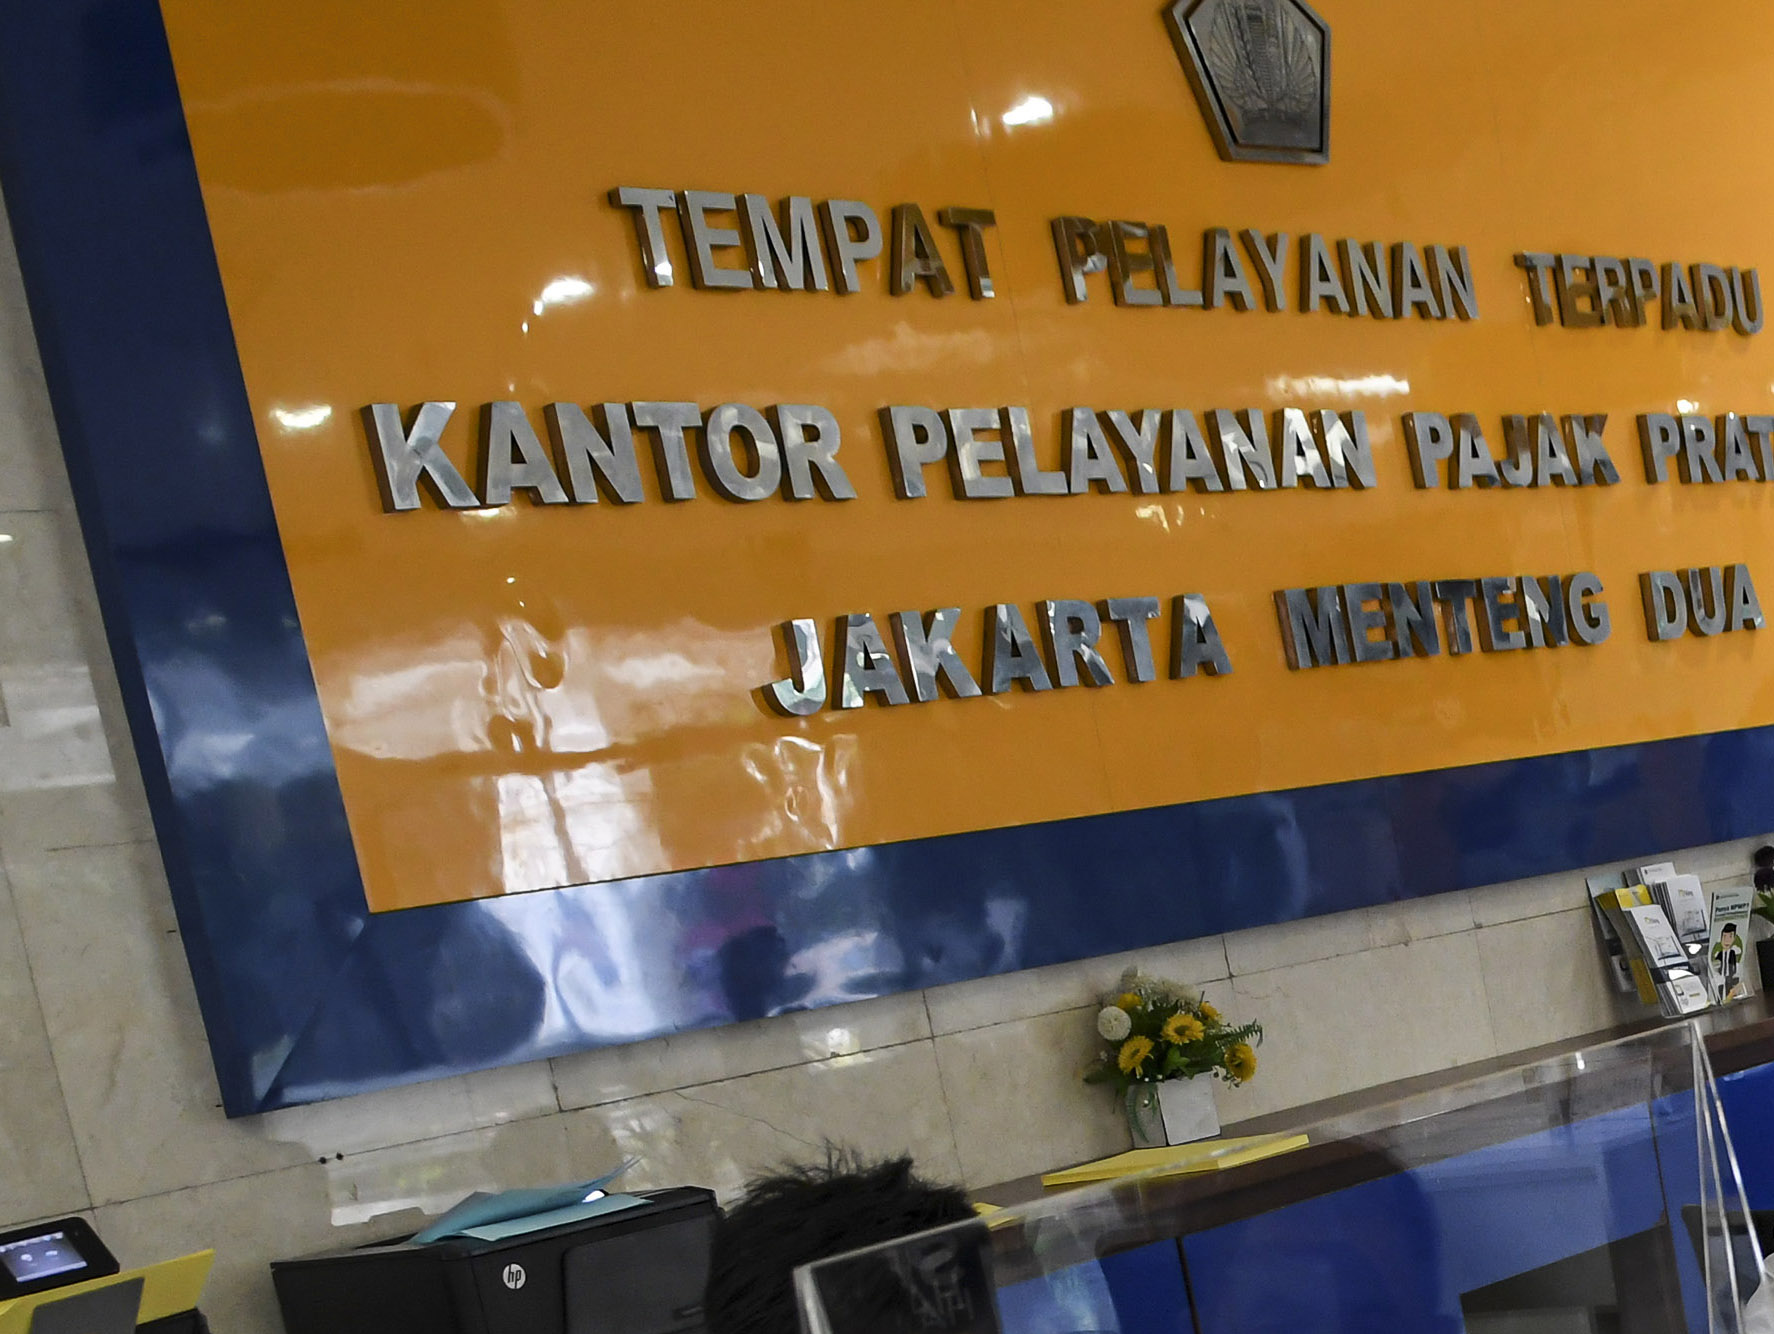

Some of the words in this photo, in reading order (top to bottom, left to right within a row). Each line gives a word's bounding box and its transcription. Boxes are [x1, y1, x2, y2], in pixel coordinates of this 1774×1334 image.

[610, 186, 996, 300] TEMPAT
[1052, 216, 1479, 322] PELAYANAN
[1512, 250, 1766, 336] TERPADU
[361, 401, 858, 513] KANTOR
[877, 405, 1377, 502] PELAYANAN
[1402, 411, 1621, 490] PAJAK
[750, 594, 1233, 718] JAKARTA
[1272, 571, 1611, 671] MENTENG
[1638, 563, 1766, 643] DUA
